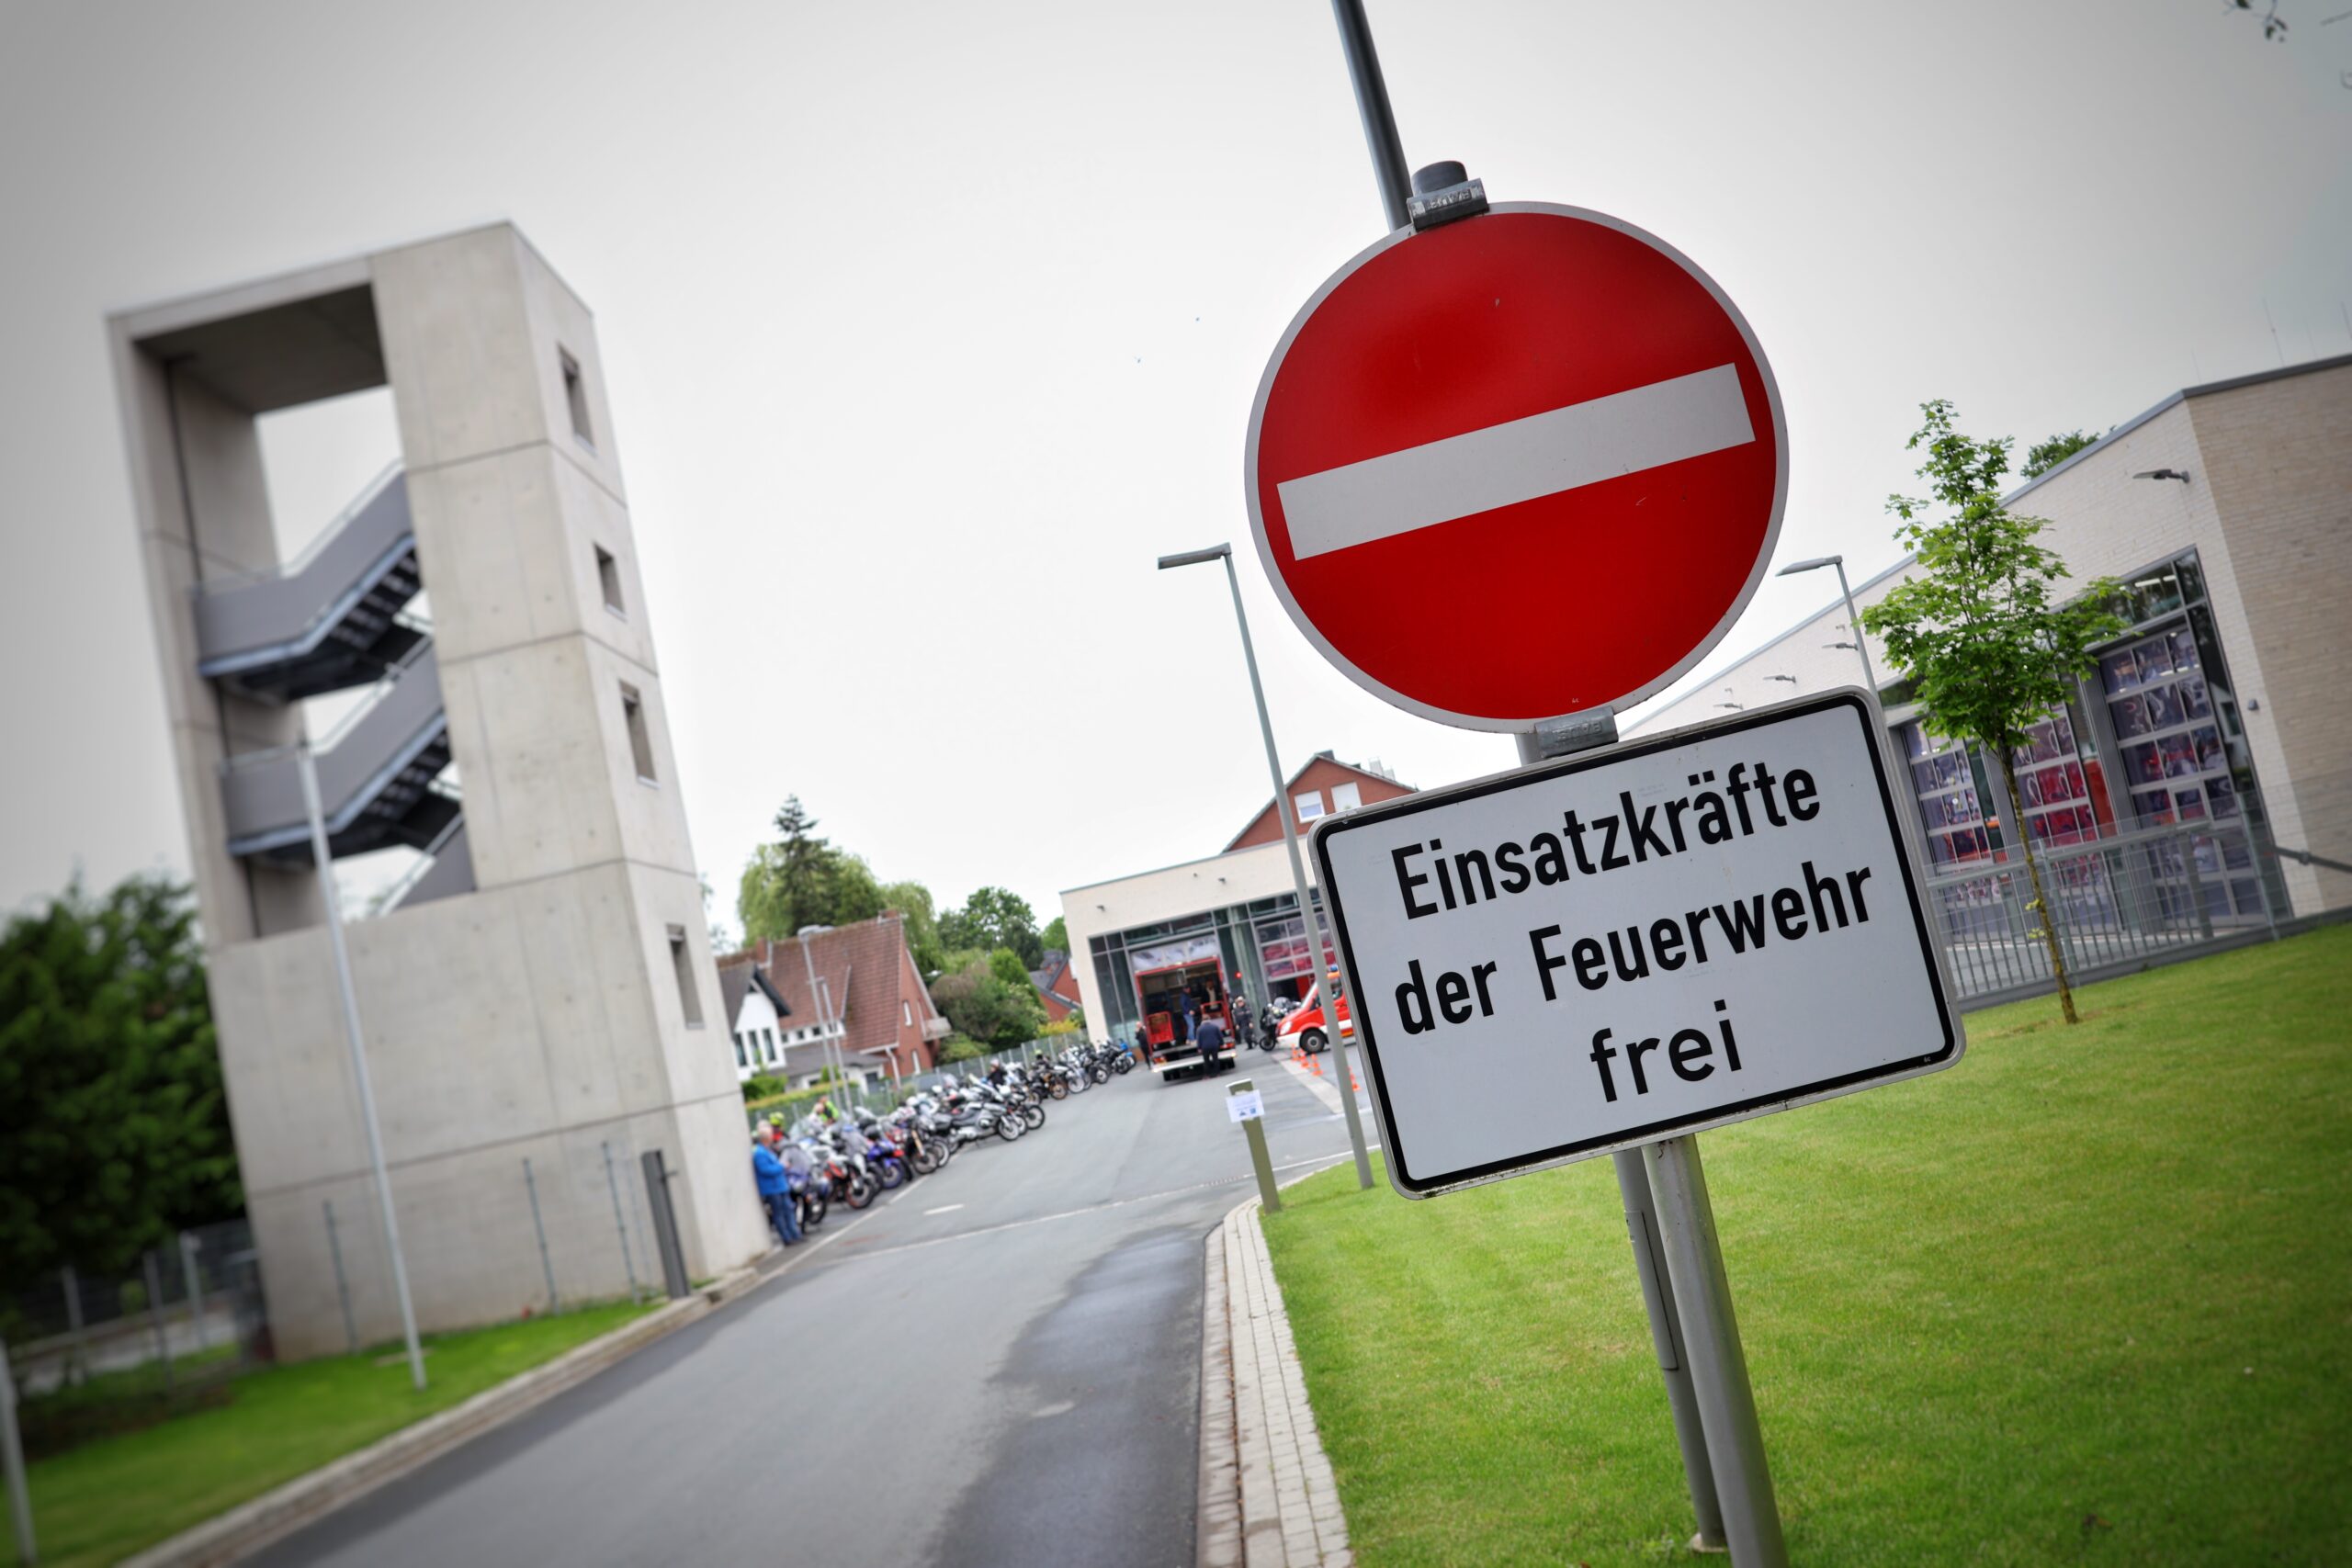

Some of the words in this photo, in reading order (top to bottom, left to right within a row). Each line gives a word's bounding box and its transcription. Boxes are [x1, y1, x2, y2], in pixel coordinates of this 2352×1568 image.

[1391, 761, 1820, 920] Einsatzkräfte
[1395, 959, 1498, 1035] der
[1528, 860, 1871, 1002] Feuerwehr
[1589, 998, 1742, 1103] frei
